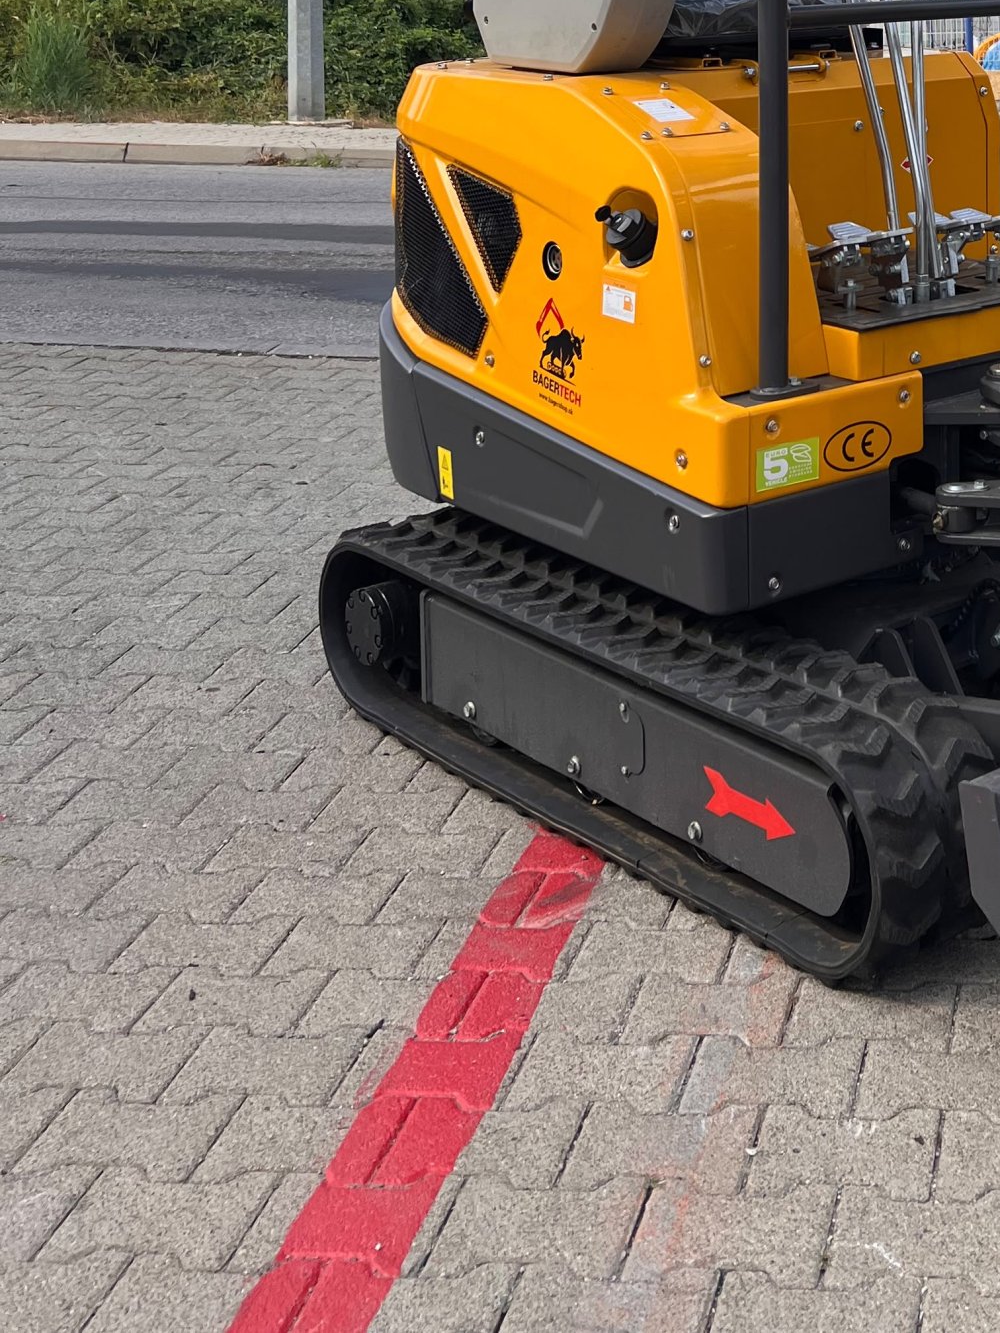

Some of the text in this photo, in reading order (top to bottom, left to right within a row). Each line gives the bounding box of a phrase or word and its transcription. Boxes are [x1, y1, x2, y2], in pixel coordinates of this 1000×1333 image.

[532, 369, 582, 407] BAGERTECH
[765, 448, 787, 458] EURO
[842, 428, 874, 462] CE
[763, 449, 788, 481] 5
